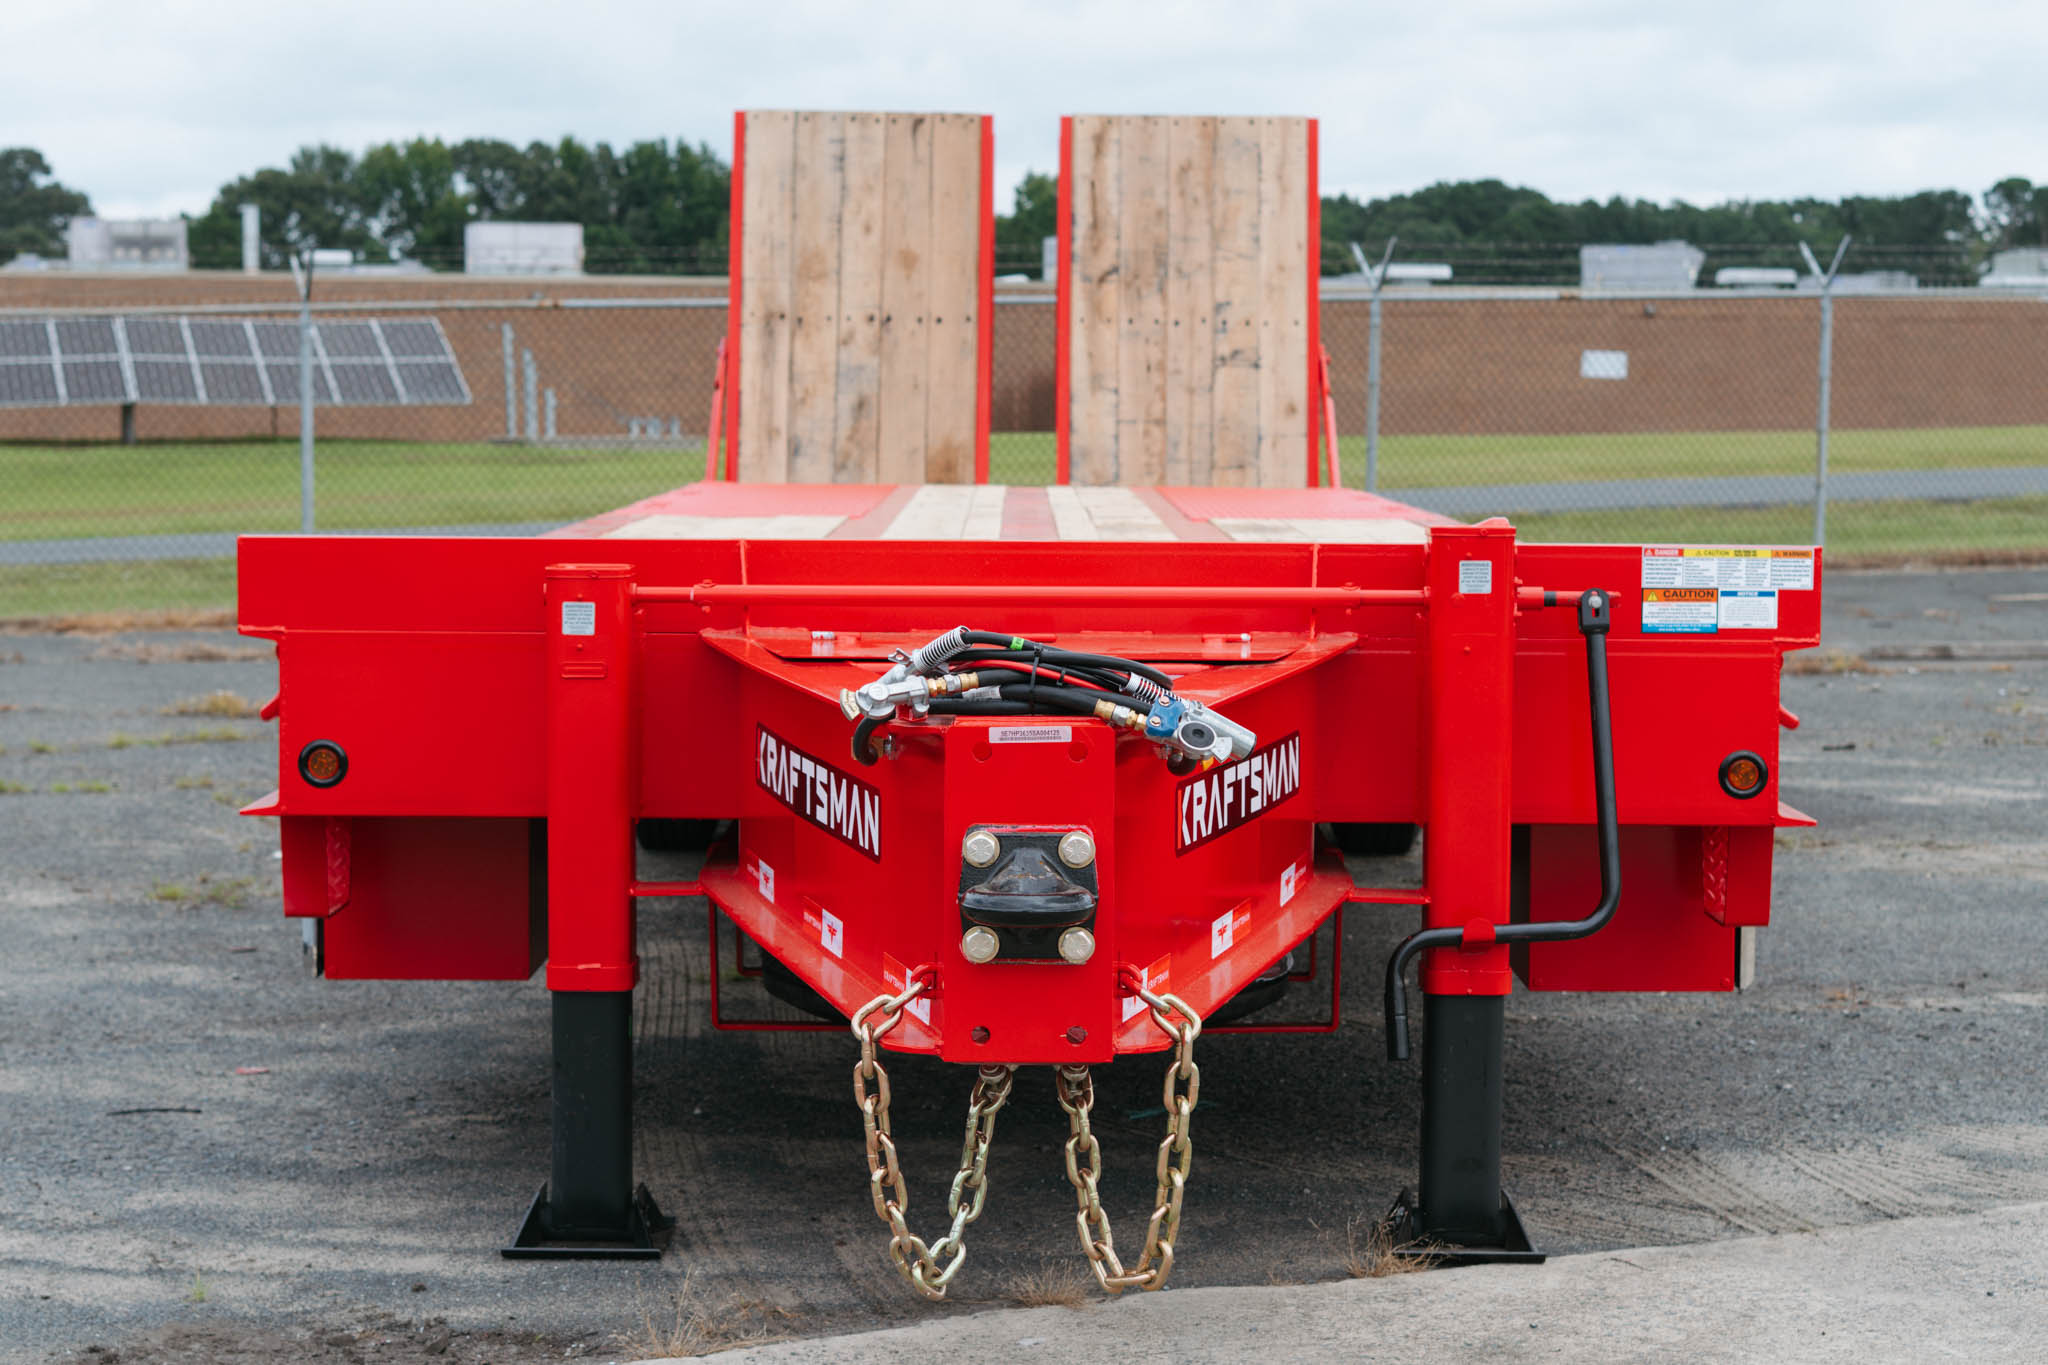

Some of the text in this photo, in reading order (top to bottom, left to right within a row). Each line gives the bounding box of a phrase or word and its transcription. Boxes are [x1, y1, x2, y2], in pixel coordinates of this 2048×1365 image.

[1663, 590, 1714, 598] CAUTION
[757, 728, 879, 856] KRAFTSMAN
[1177, 736, 1300, 849] KRAFTSMAN
